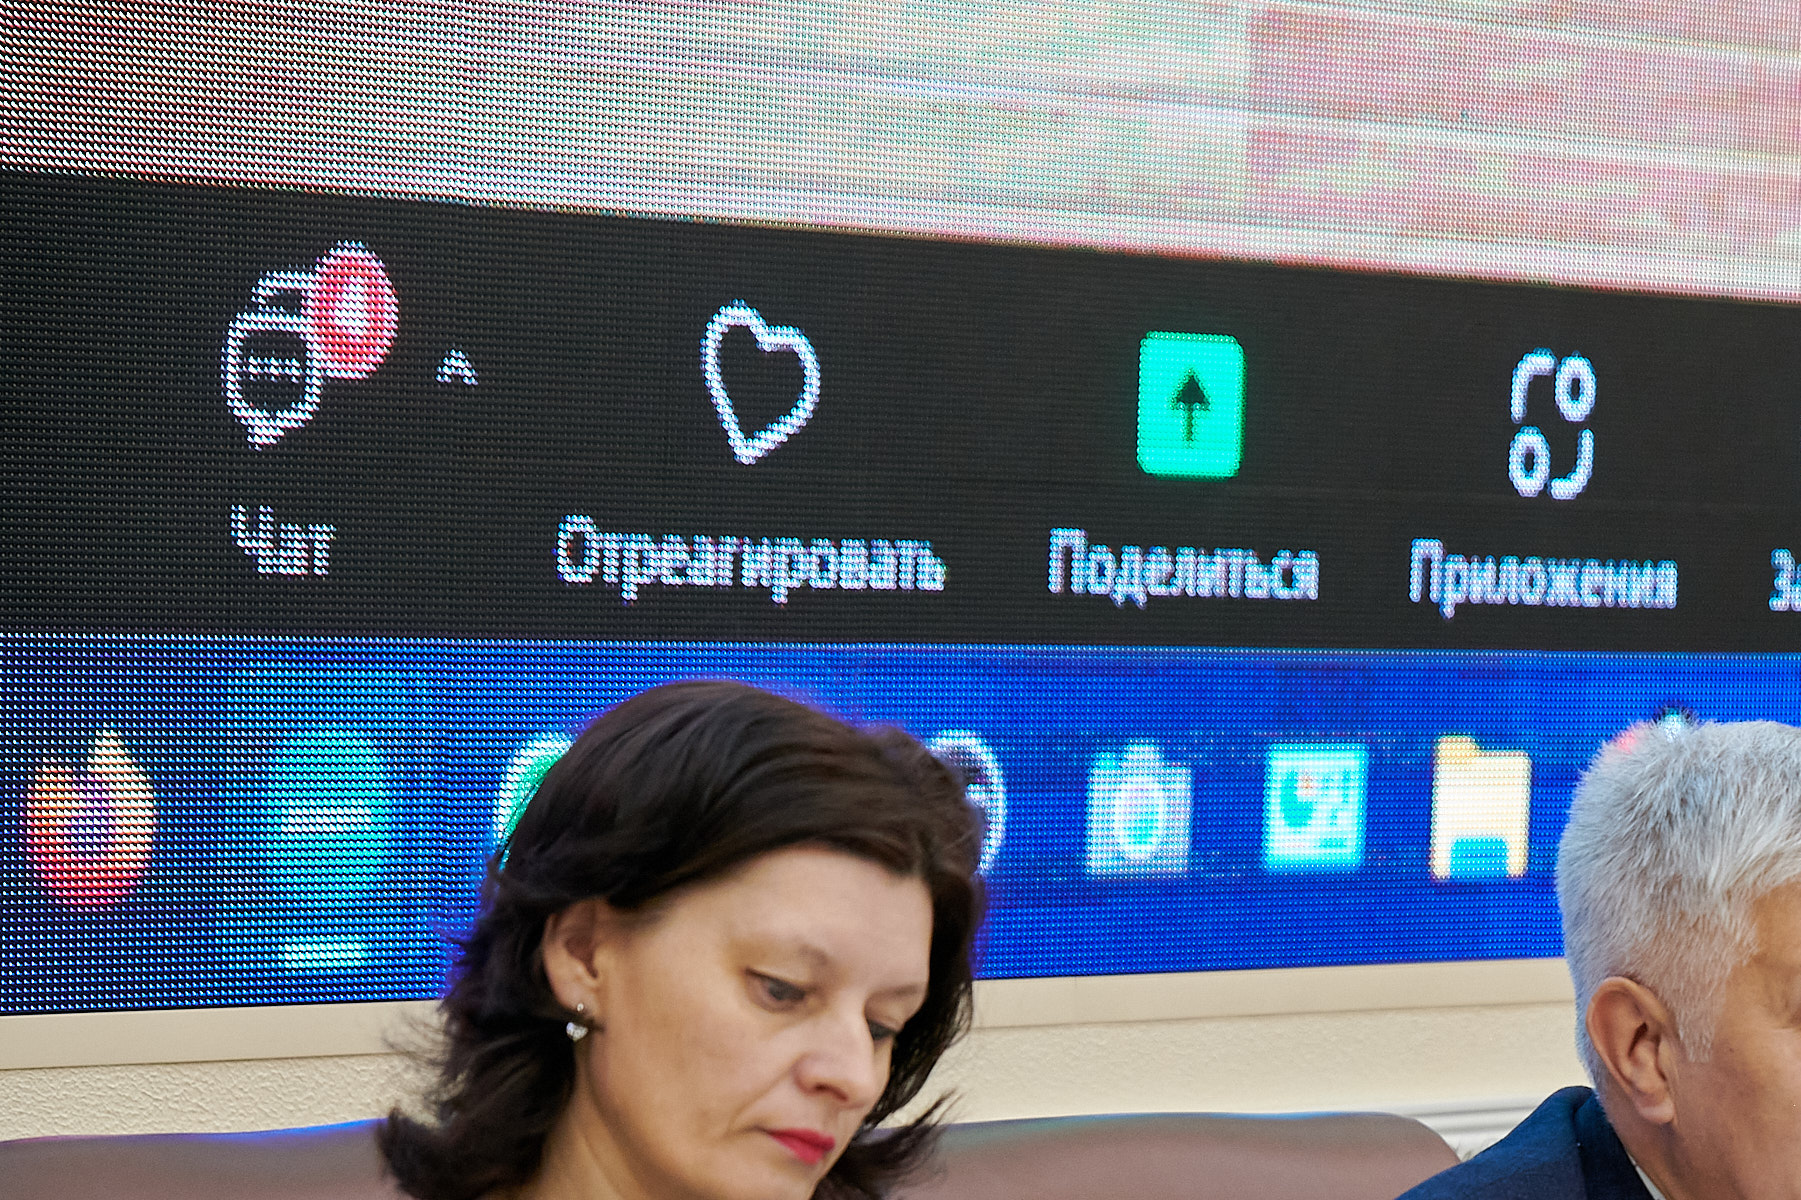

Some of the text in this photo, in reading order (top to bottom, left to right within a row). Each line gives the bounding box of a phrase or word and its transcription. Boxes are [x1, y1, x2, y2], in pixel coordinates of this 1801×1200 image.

[230, 505, 337, 578] Чат
[556, 514, 948, 605] Отреагировать
[1048, 528, 1320, 607] Поделиться
[1410, 538, 1678, 619] Приложения
